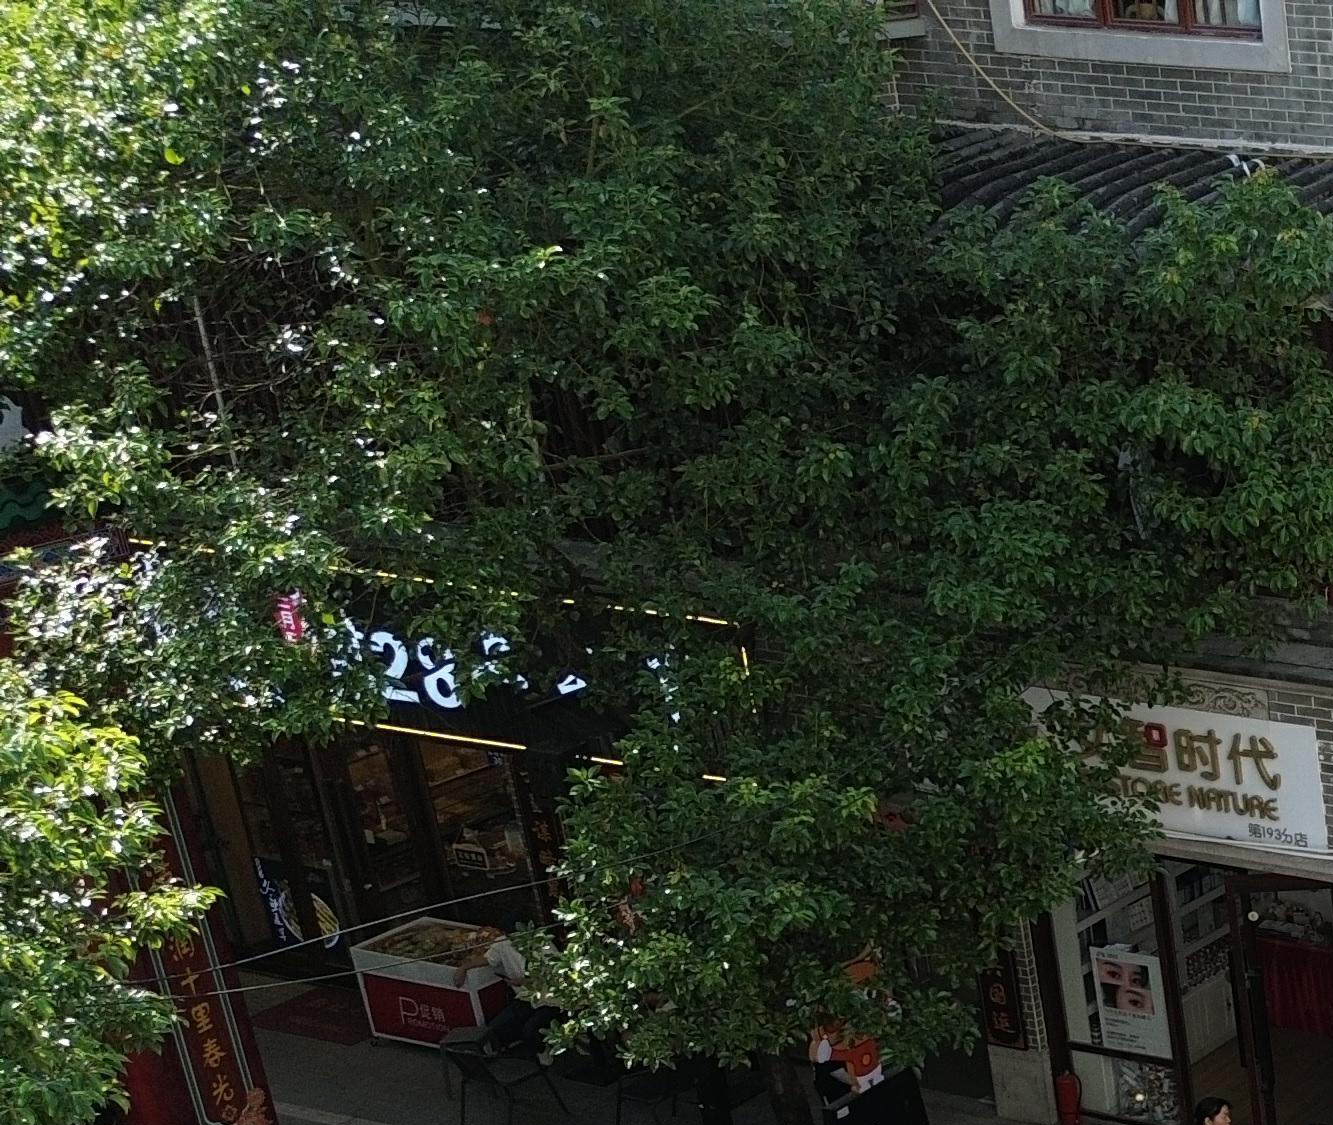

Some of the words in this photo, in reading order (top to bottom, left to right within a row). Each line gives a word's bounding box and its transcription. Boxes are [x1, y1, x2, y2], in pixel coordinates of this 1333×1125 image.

[1187, 783, 1281, 822] NATURE
[1248, 822, 1308, 848] 第193分店
